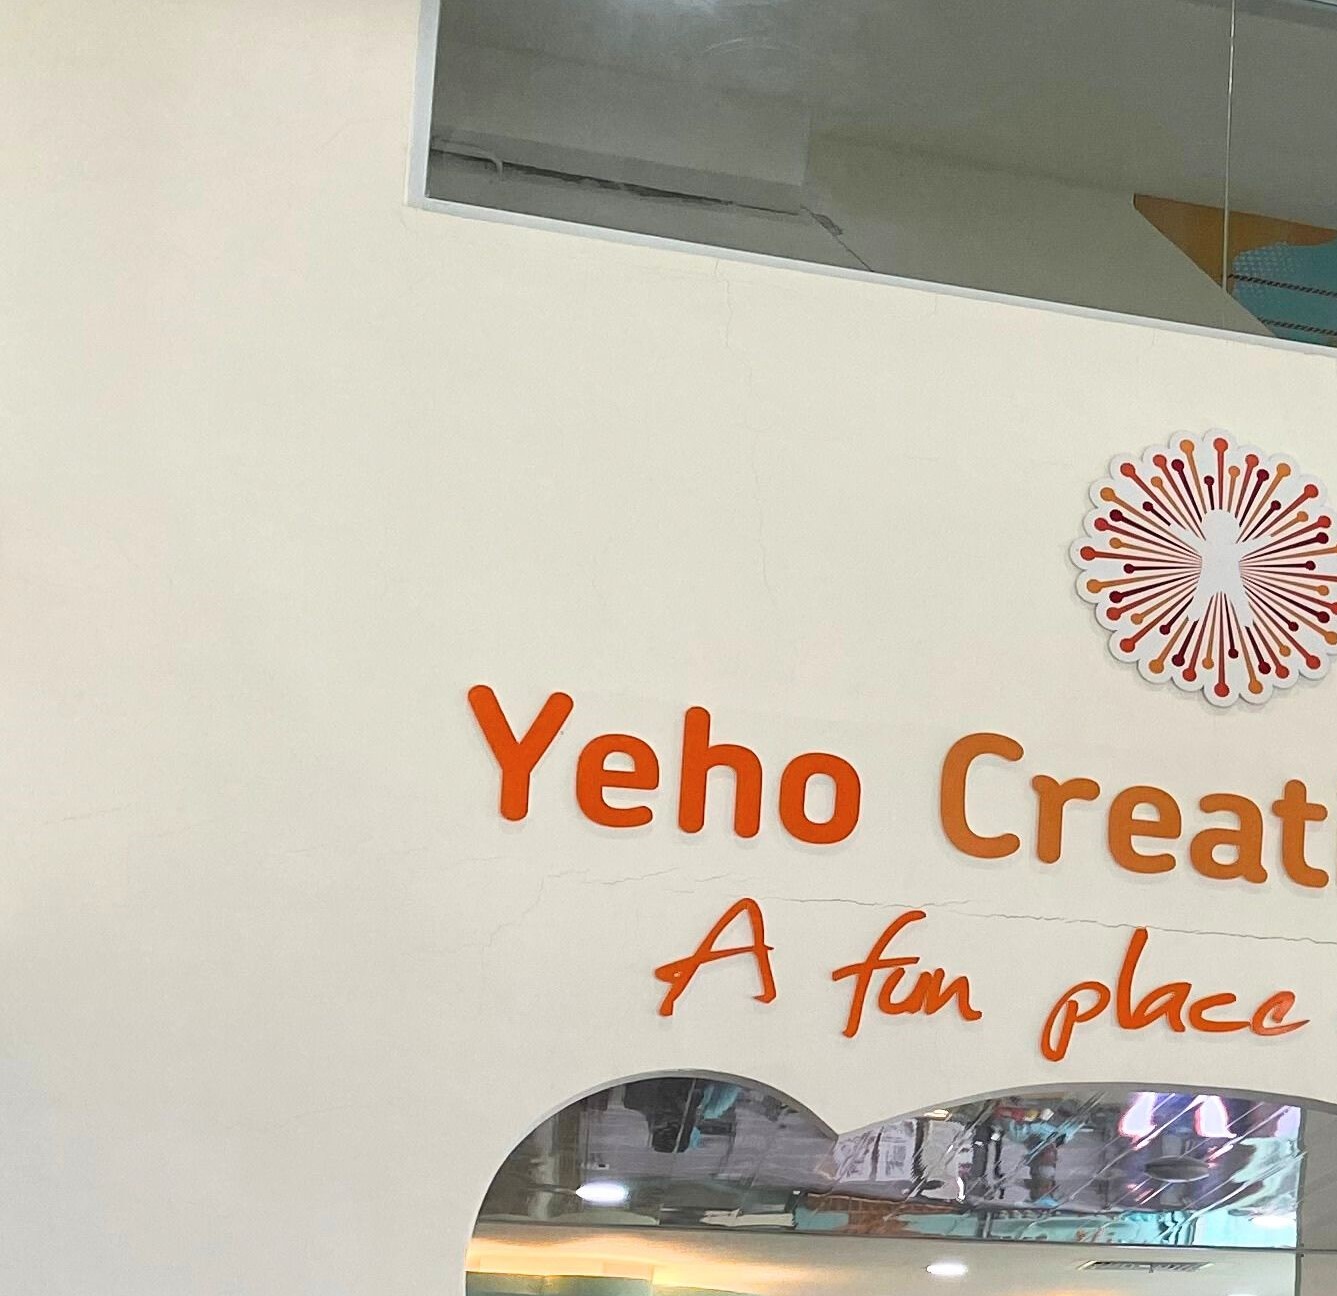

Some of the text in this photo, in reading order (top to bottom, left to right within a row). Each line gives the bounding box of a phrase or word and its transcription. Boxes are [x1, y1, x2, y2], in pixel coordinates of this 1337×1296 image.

[468, 685, 861, 844] Yeho
[654, 898, 776, 1016] A
[832, 910, 982, 1038] fun
[1041, 927, 1310, 1062] place
